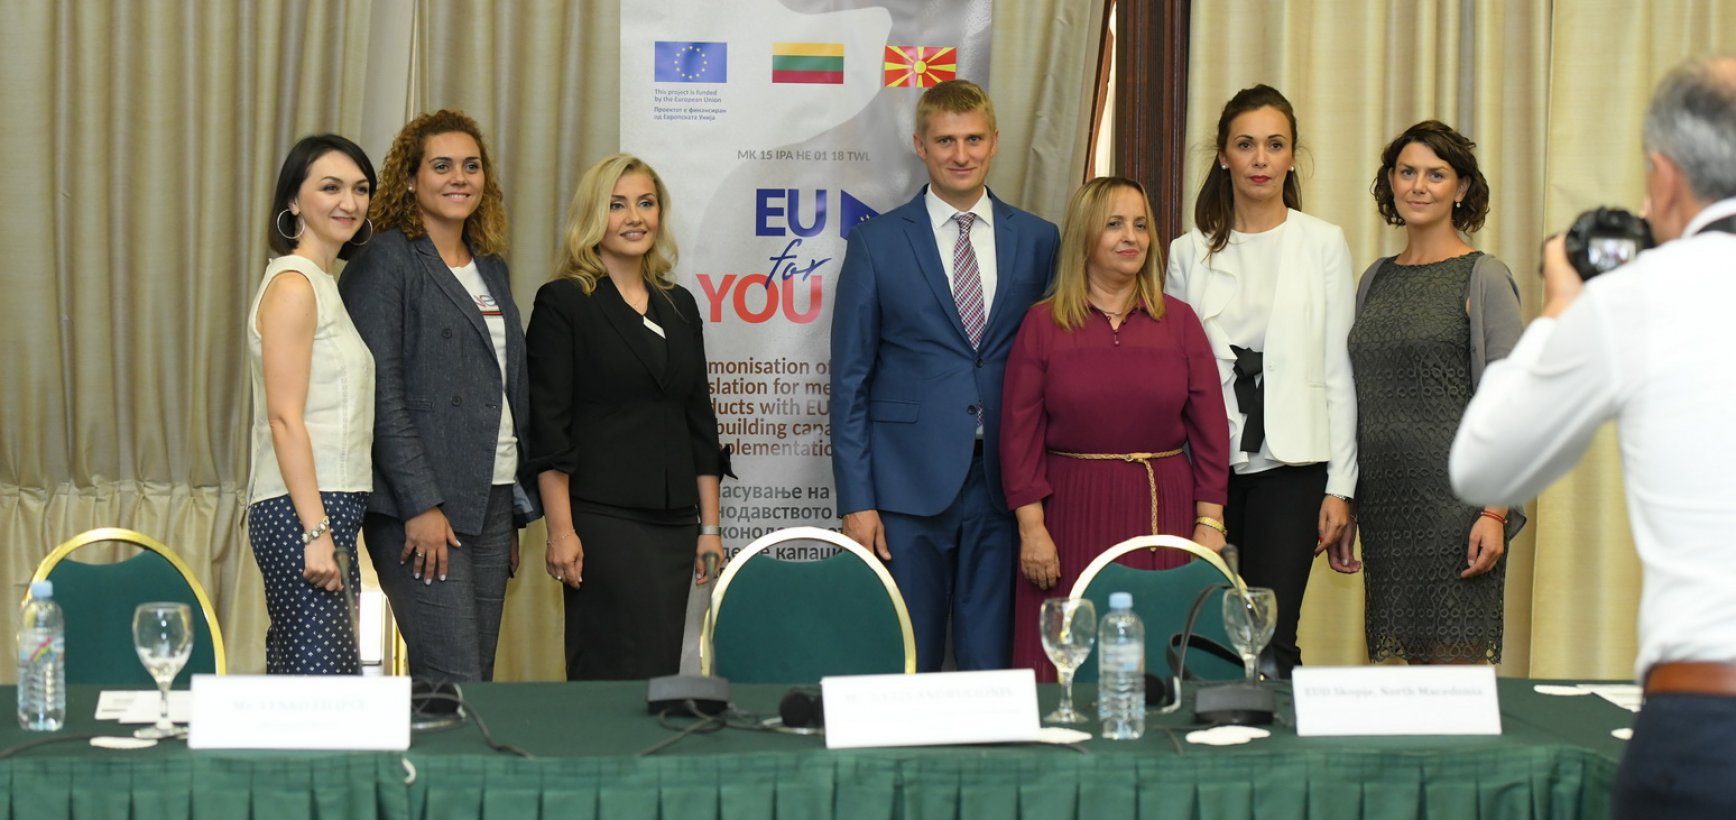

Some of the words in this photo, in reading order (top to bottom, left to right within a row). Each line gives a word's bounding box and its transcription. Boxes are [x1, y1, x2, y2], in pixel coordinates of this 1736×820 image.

[668, 89, 689, 97] project
[737, 150, 757, 160] MK
[760, 151, 773, 161] 15
[776, 151, 794, 161] IPA
[796, 151, 812, 161] HE
[814, 151, 828, 161] 01
[832, 151, 845, 161] 18
[847, 152, 871, 162] TWL
[756, 188, 827, 238] EU
[769, 238, 833, 290] for
[695, 273, 823, 324] YOU
[708, 356, 810, 375] monisation
[708, 377, 768, 395] slation
[773, 377, 799, 394] for
[805, 382, 832, 396] me
[760, 398, 801, 416] with
[806, 400, 831, 416] EU
[808, 486, 830, 499] на
